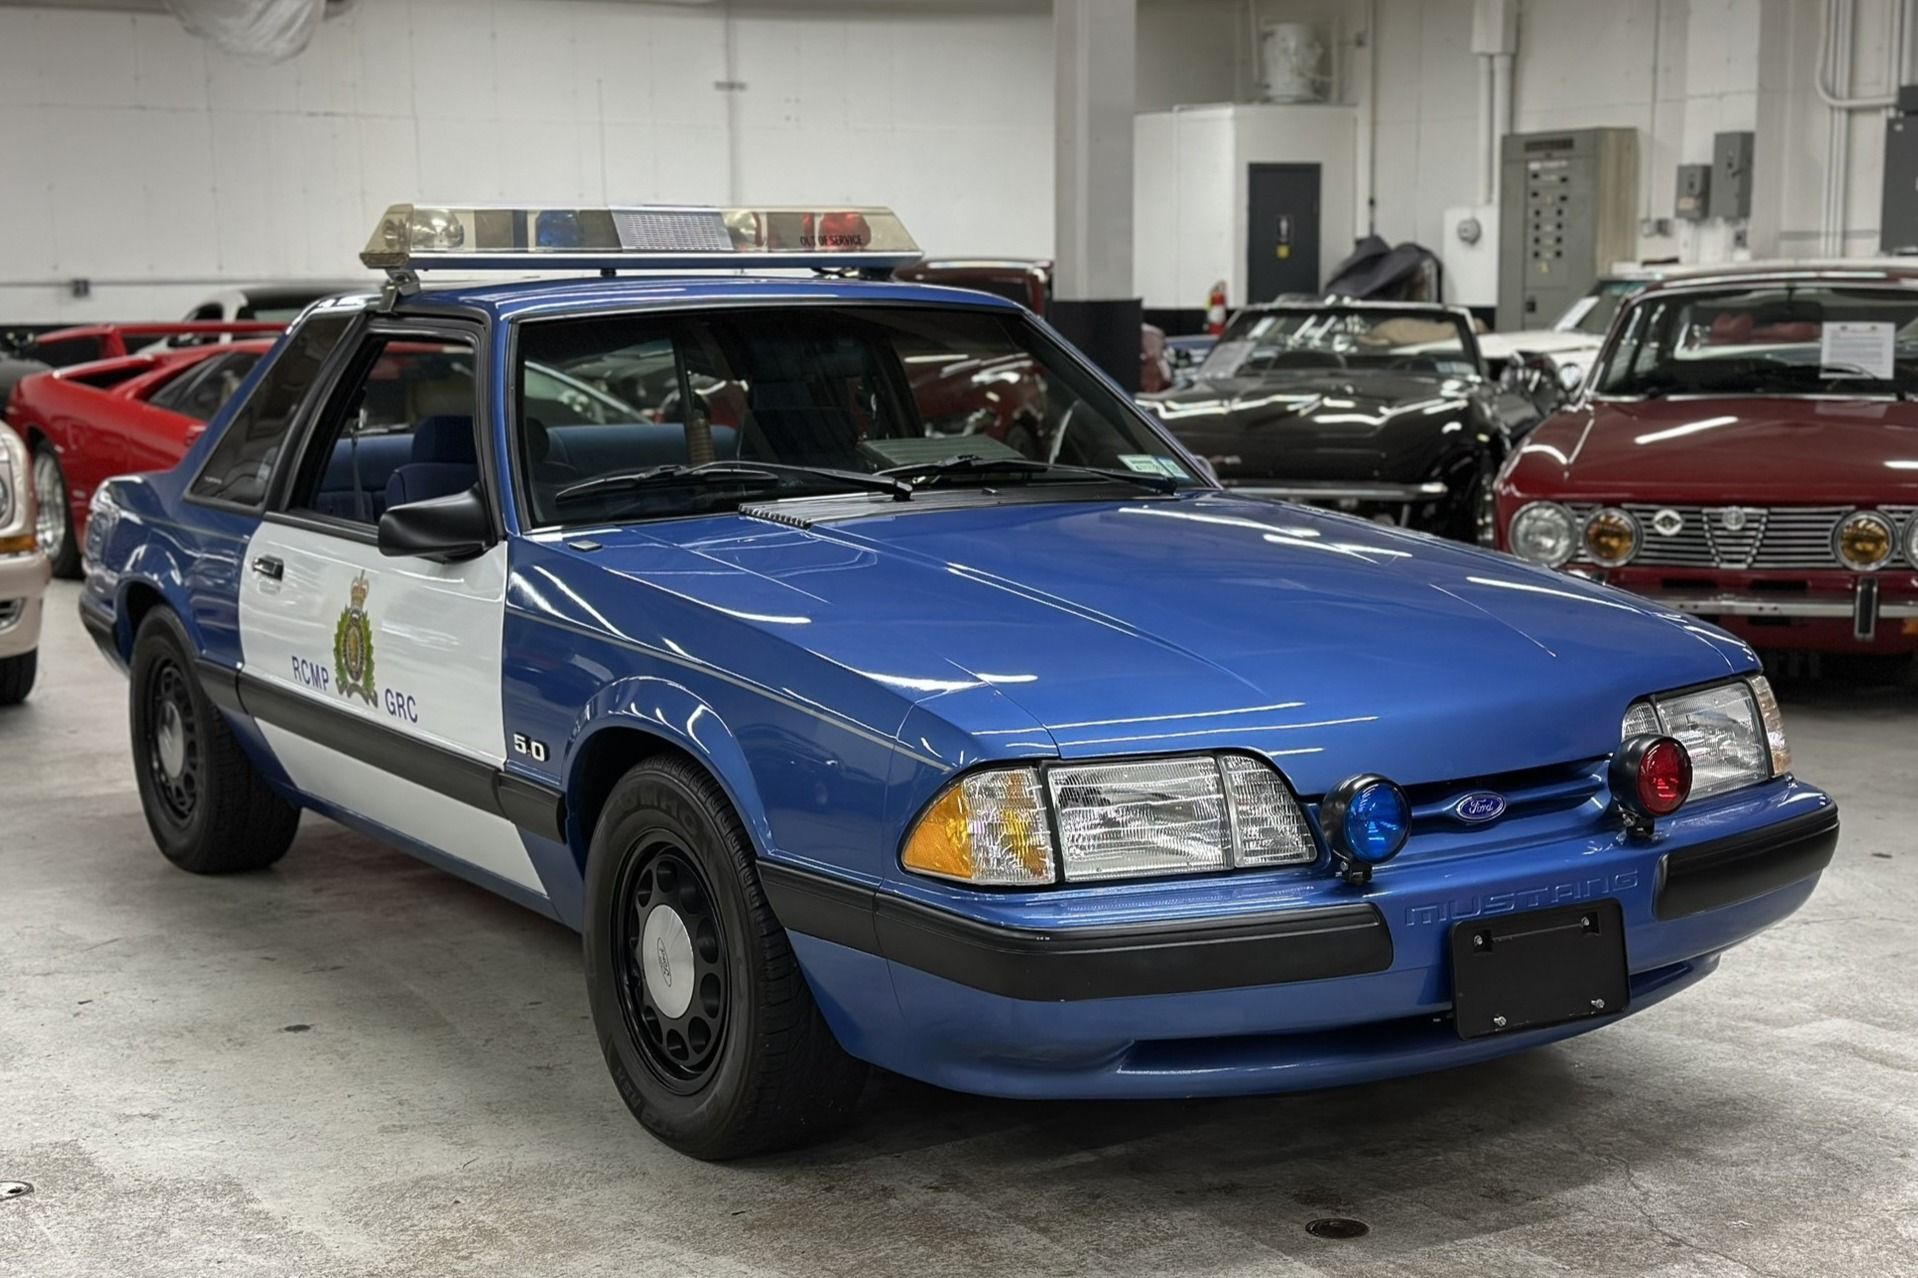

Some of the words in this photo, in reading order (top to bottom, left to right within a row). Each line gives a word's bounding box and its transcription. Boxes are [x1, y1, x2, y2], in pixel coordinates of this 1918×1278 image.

[799, 235, 816, 248] OUT
[817, 235, 828, 247] OF
[829, 234, 863, 247] SERVICE
[291, 655, 329, 692] RCMP
[384, 688, 418, 723] GRC
[513, 732, 547, 762] 5.0
[1468, 799, 1494, 814] Ford
[1405, 868, 1639, 927] MUSTANG
